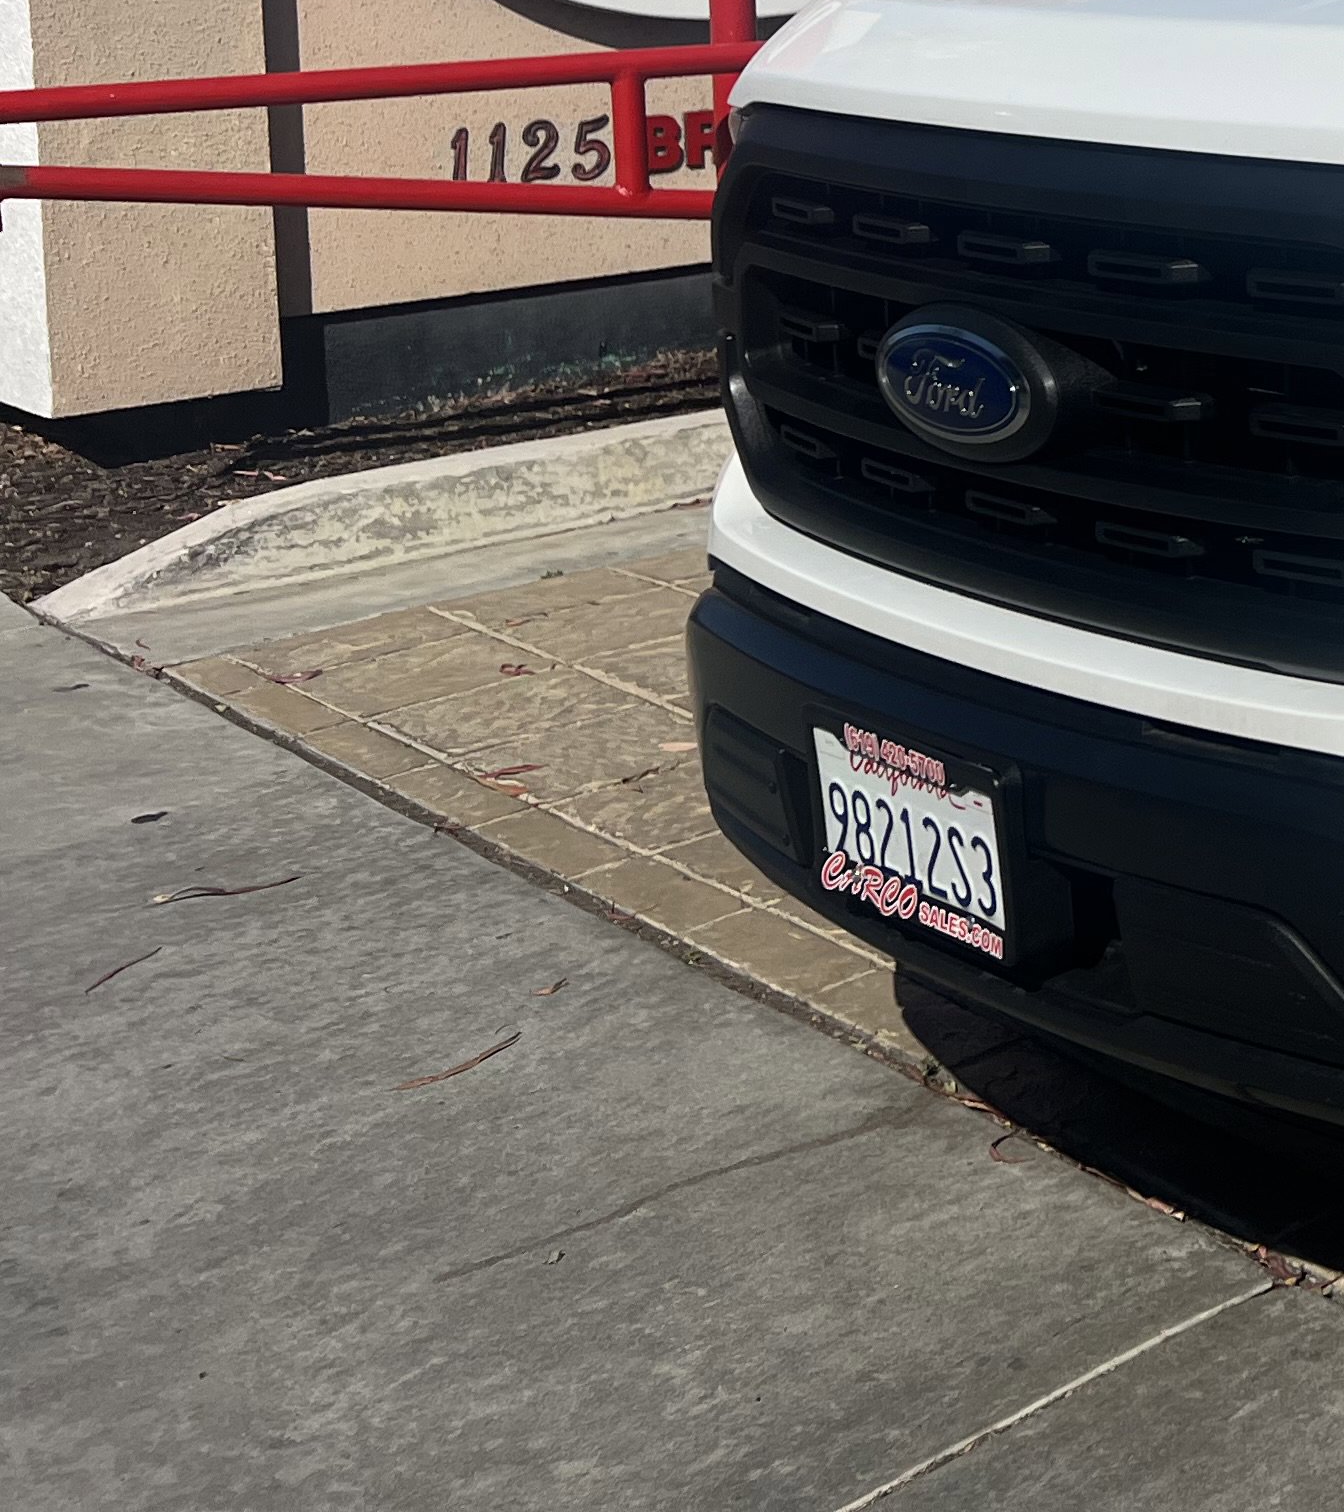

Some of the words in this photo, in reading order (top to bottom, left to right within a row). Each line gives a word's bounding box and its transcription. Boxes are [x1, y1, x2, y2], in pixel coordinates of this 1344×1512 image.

[451, 114, 612, 182] 1125
[904, 348, 986, 419] Ford
[829, 782, 996, 917] 98212S3
